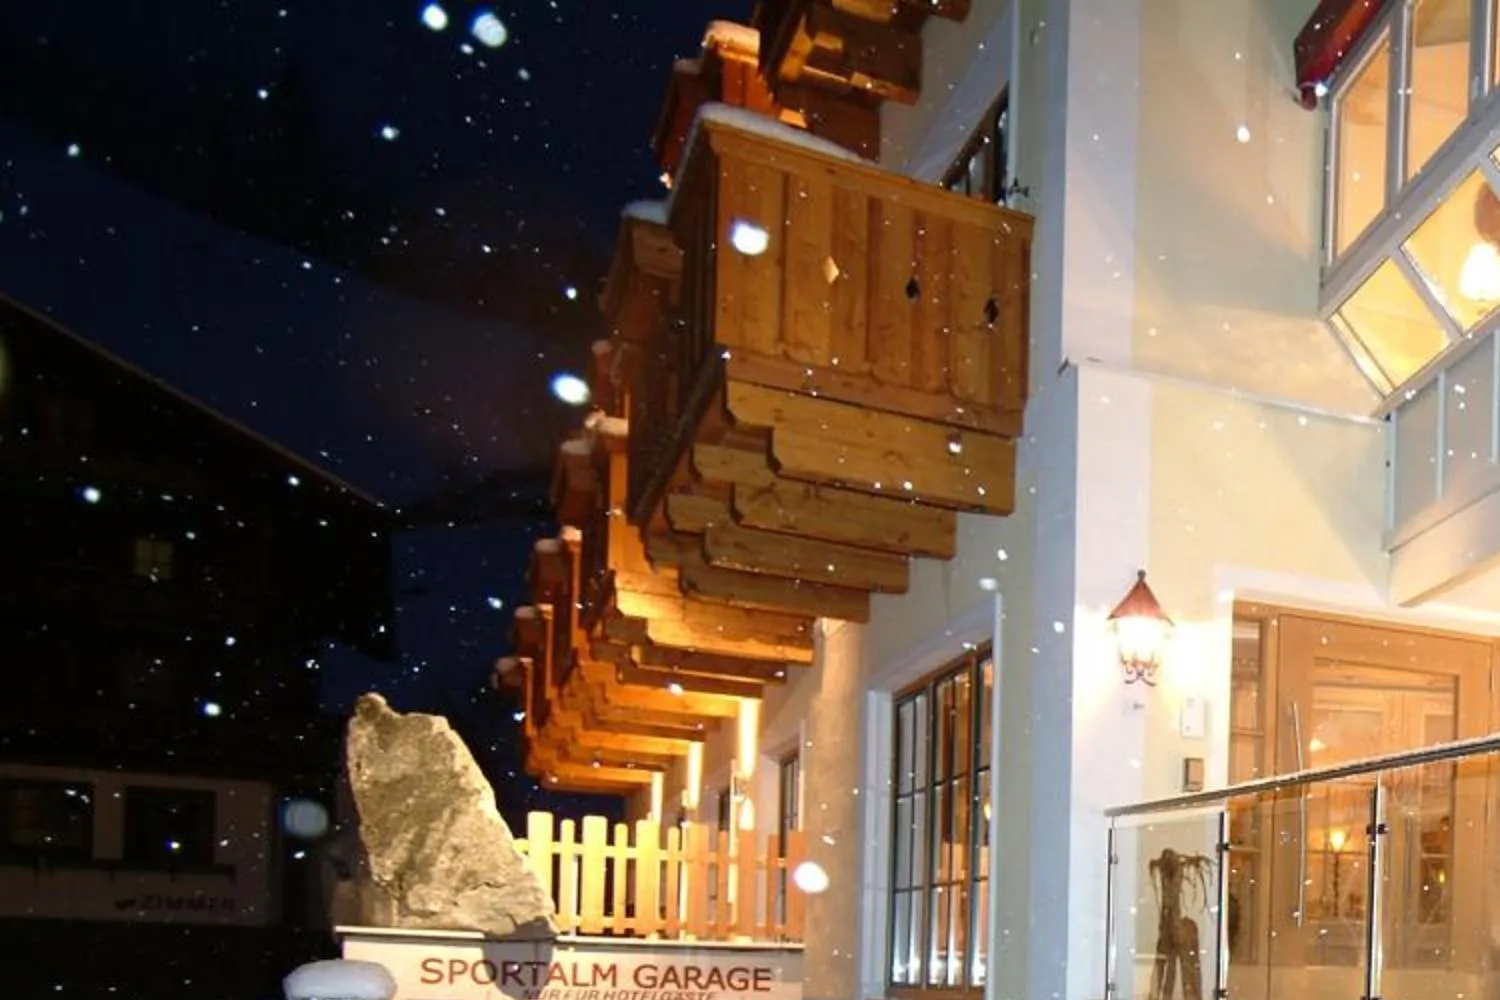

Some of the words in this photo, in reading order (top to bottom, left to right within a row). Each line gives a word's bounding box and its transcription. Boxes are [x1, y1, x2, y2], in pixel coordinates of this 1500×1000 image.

[419, 957, 618, 989] SPORTALM
[632, 963, 772, 992] GARAGE
[523, 988, 561, 1000] NUR
